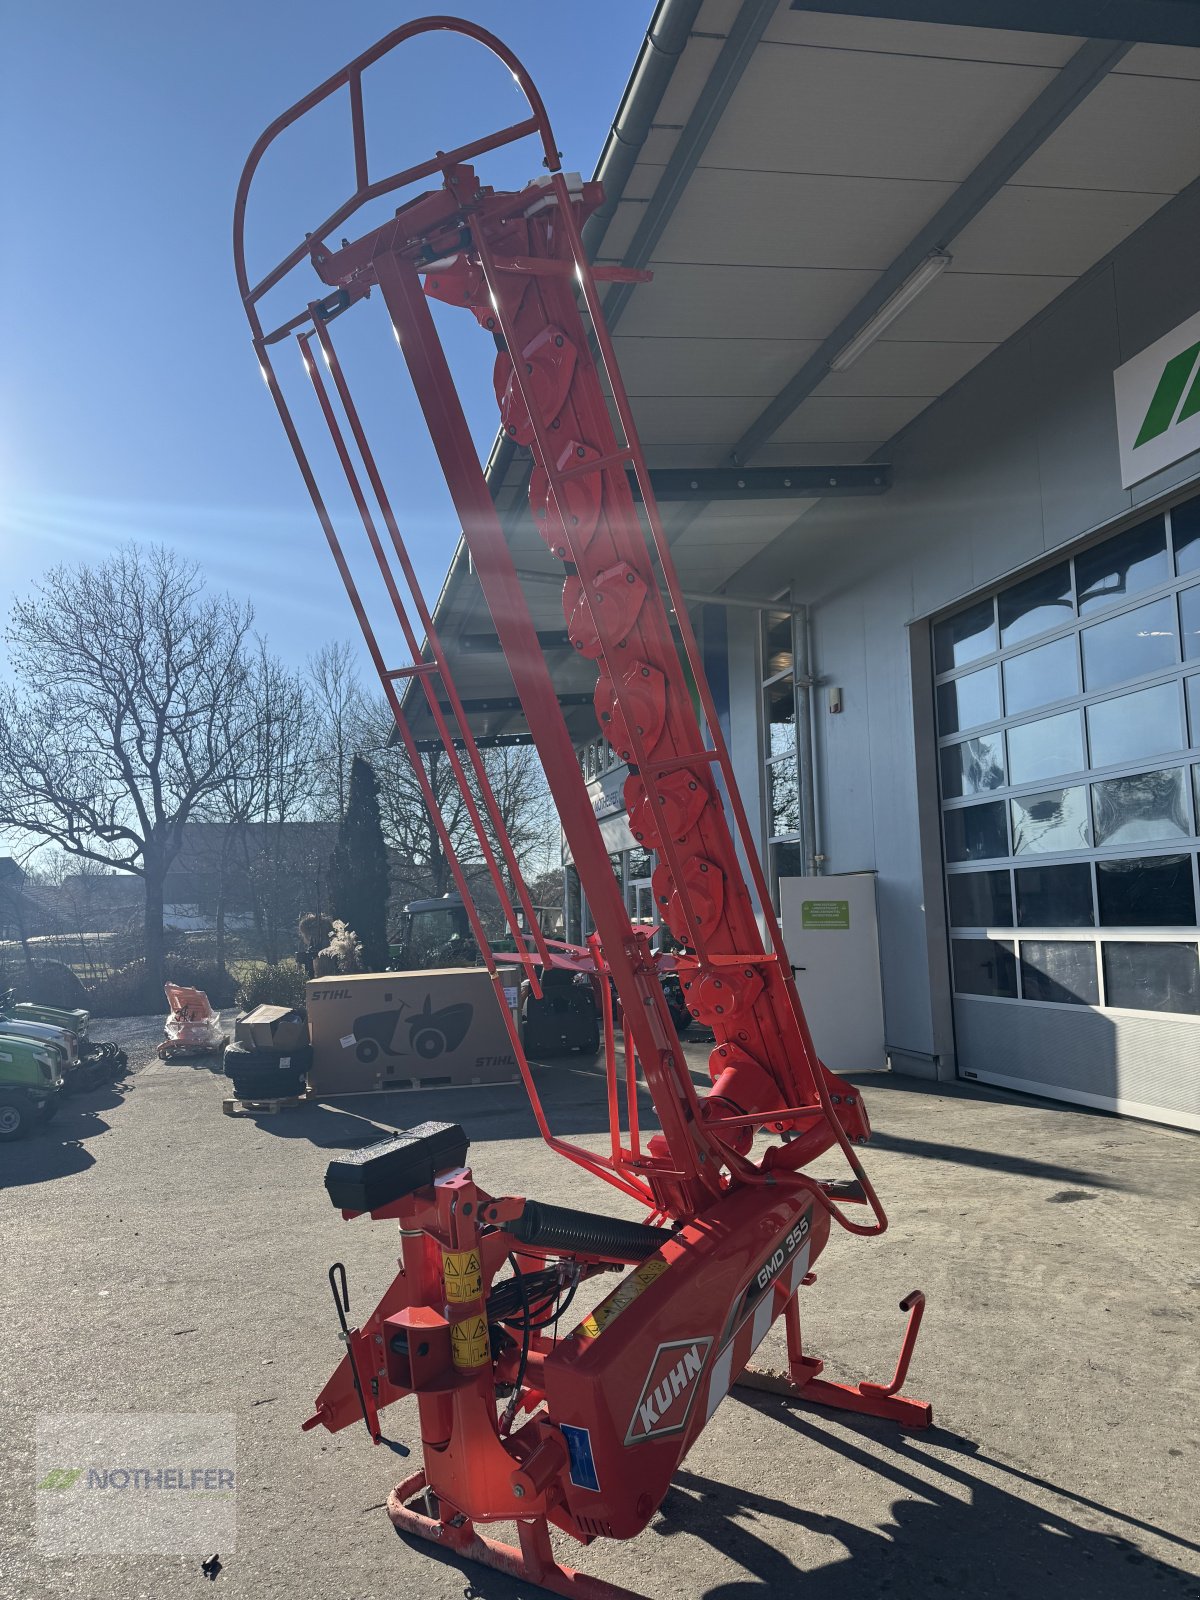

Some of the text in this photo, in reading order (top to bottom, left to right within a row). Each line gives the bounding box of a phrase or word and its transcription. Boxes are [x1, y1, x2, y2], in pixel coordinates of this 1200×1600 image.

[311, 989, 353, 1001] STIHL
[475, 1056, 515, 1067] STIHL
[757, 1217, 809, 1289] GMD 355
[639, 1344, 703, 1434] KUHN
